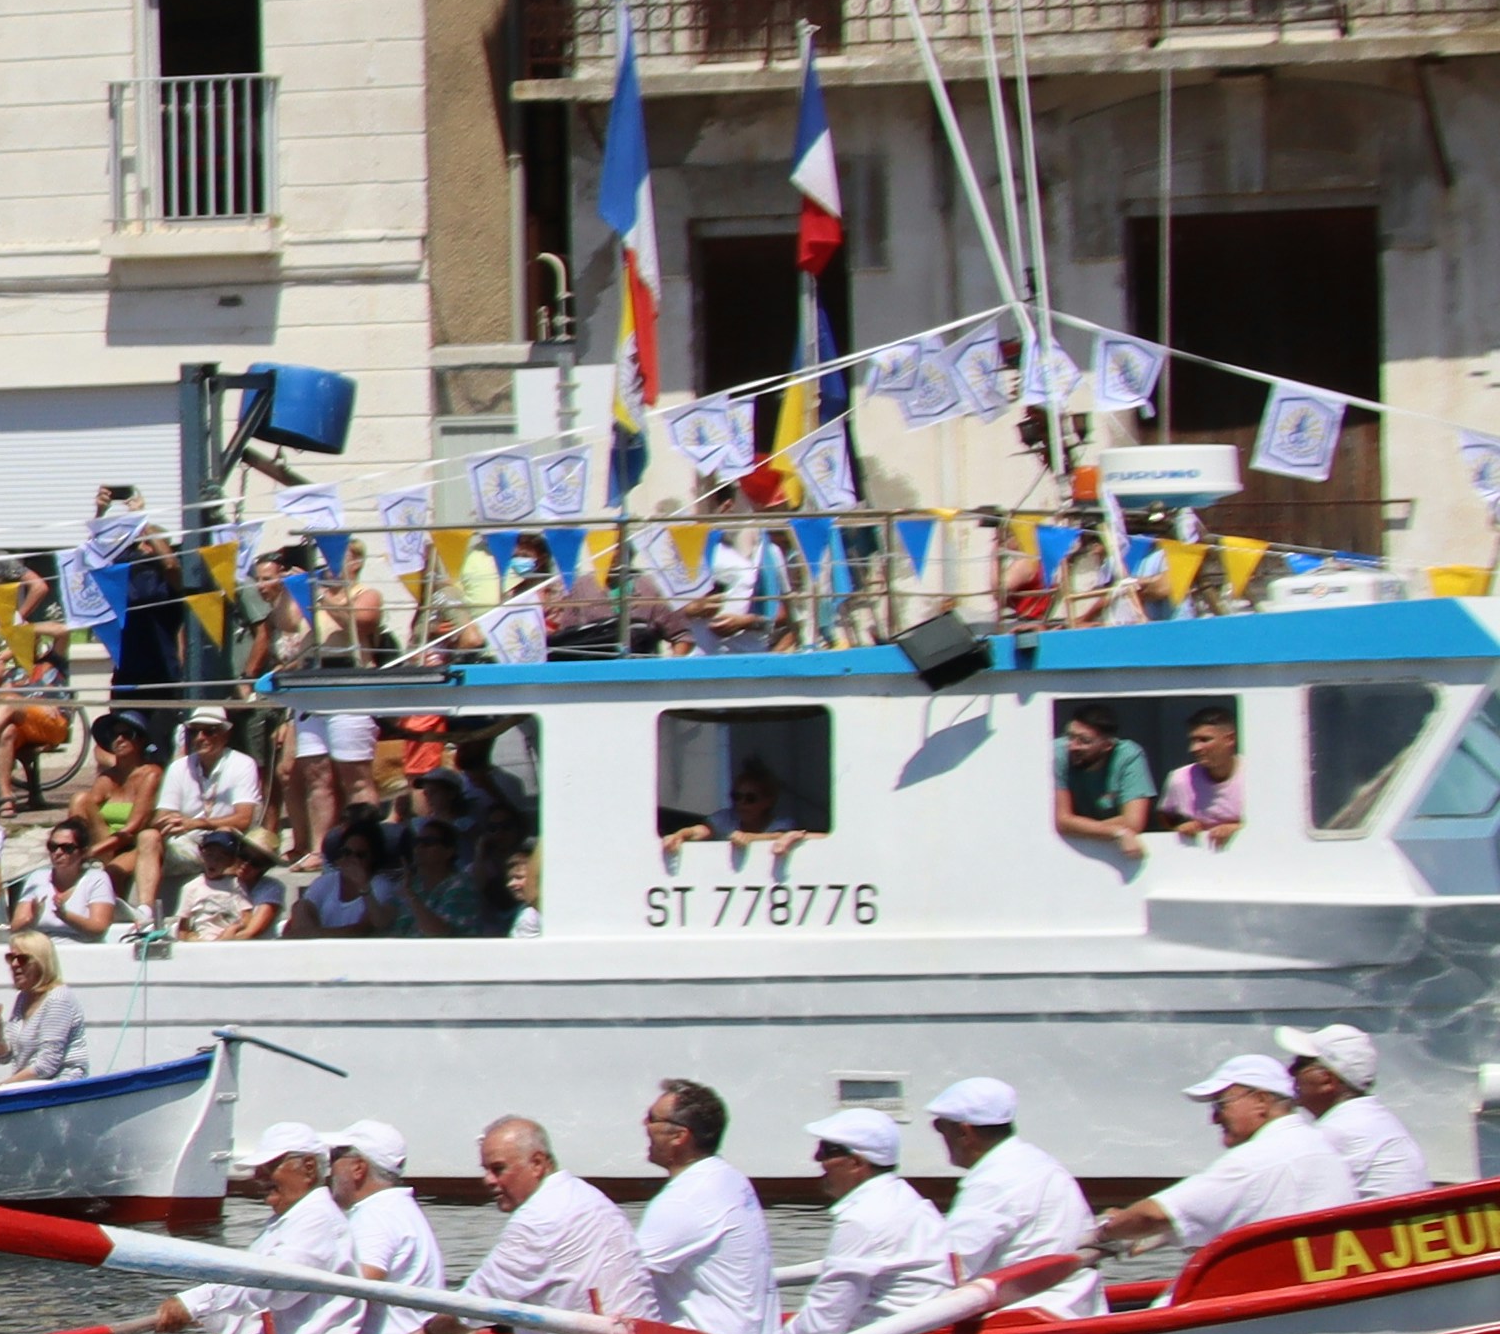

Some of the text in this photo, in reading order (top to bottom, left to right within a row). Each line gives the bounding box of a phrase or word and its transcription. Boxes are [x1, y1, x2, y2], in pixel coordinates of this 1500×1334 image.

[646, 883, 880, 928] ST 778776
[1293, 1229, 1377, 1283] LA
